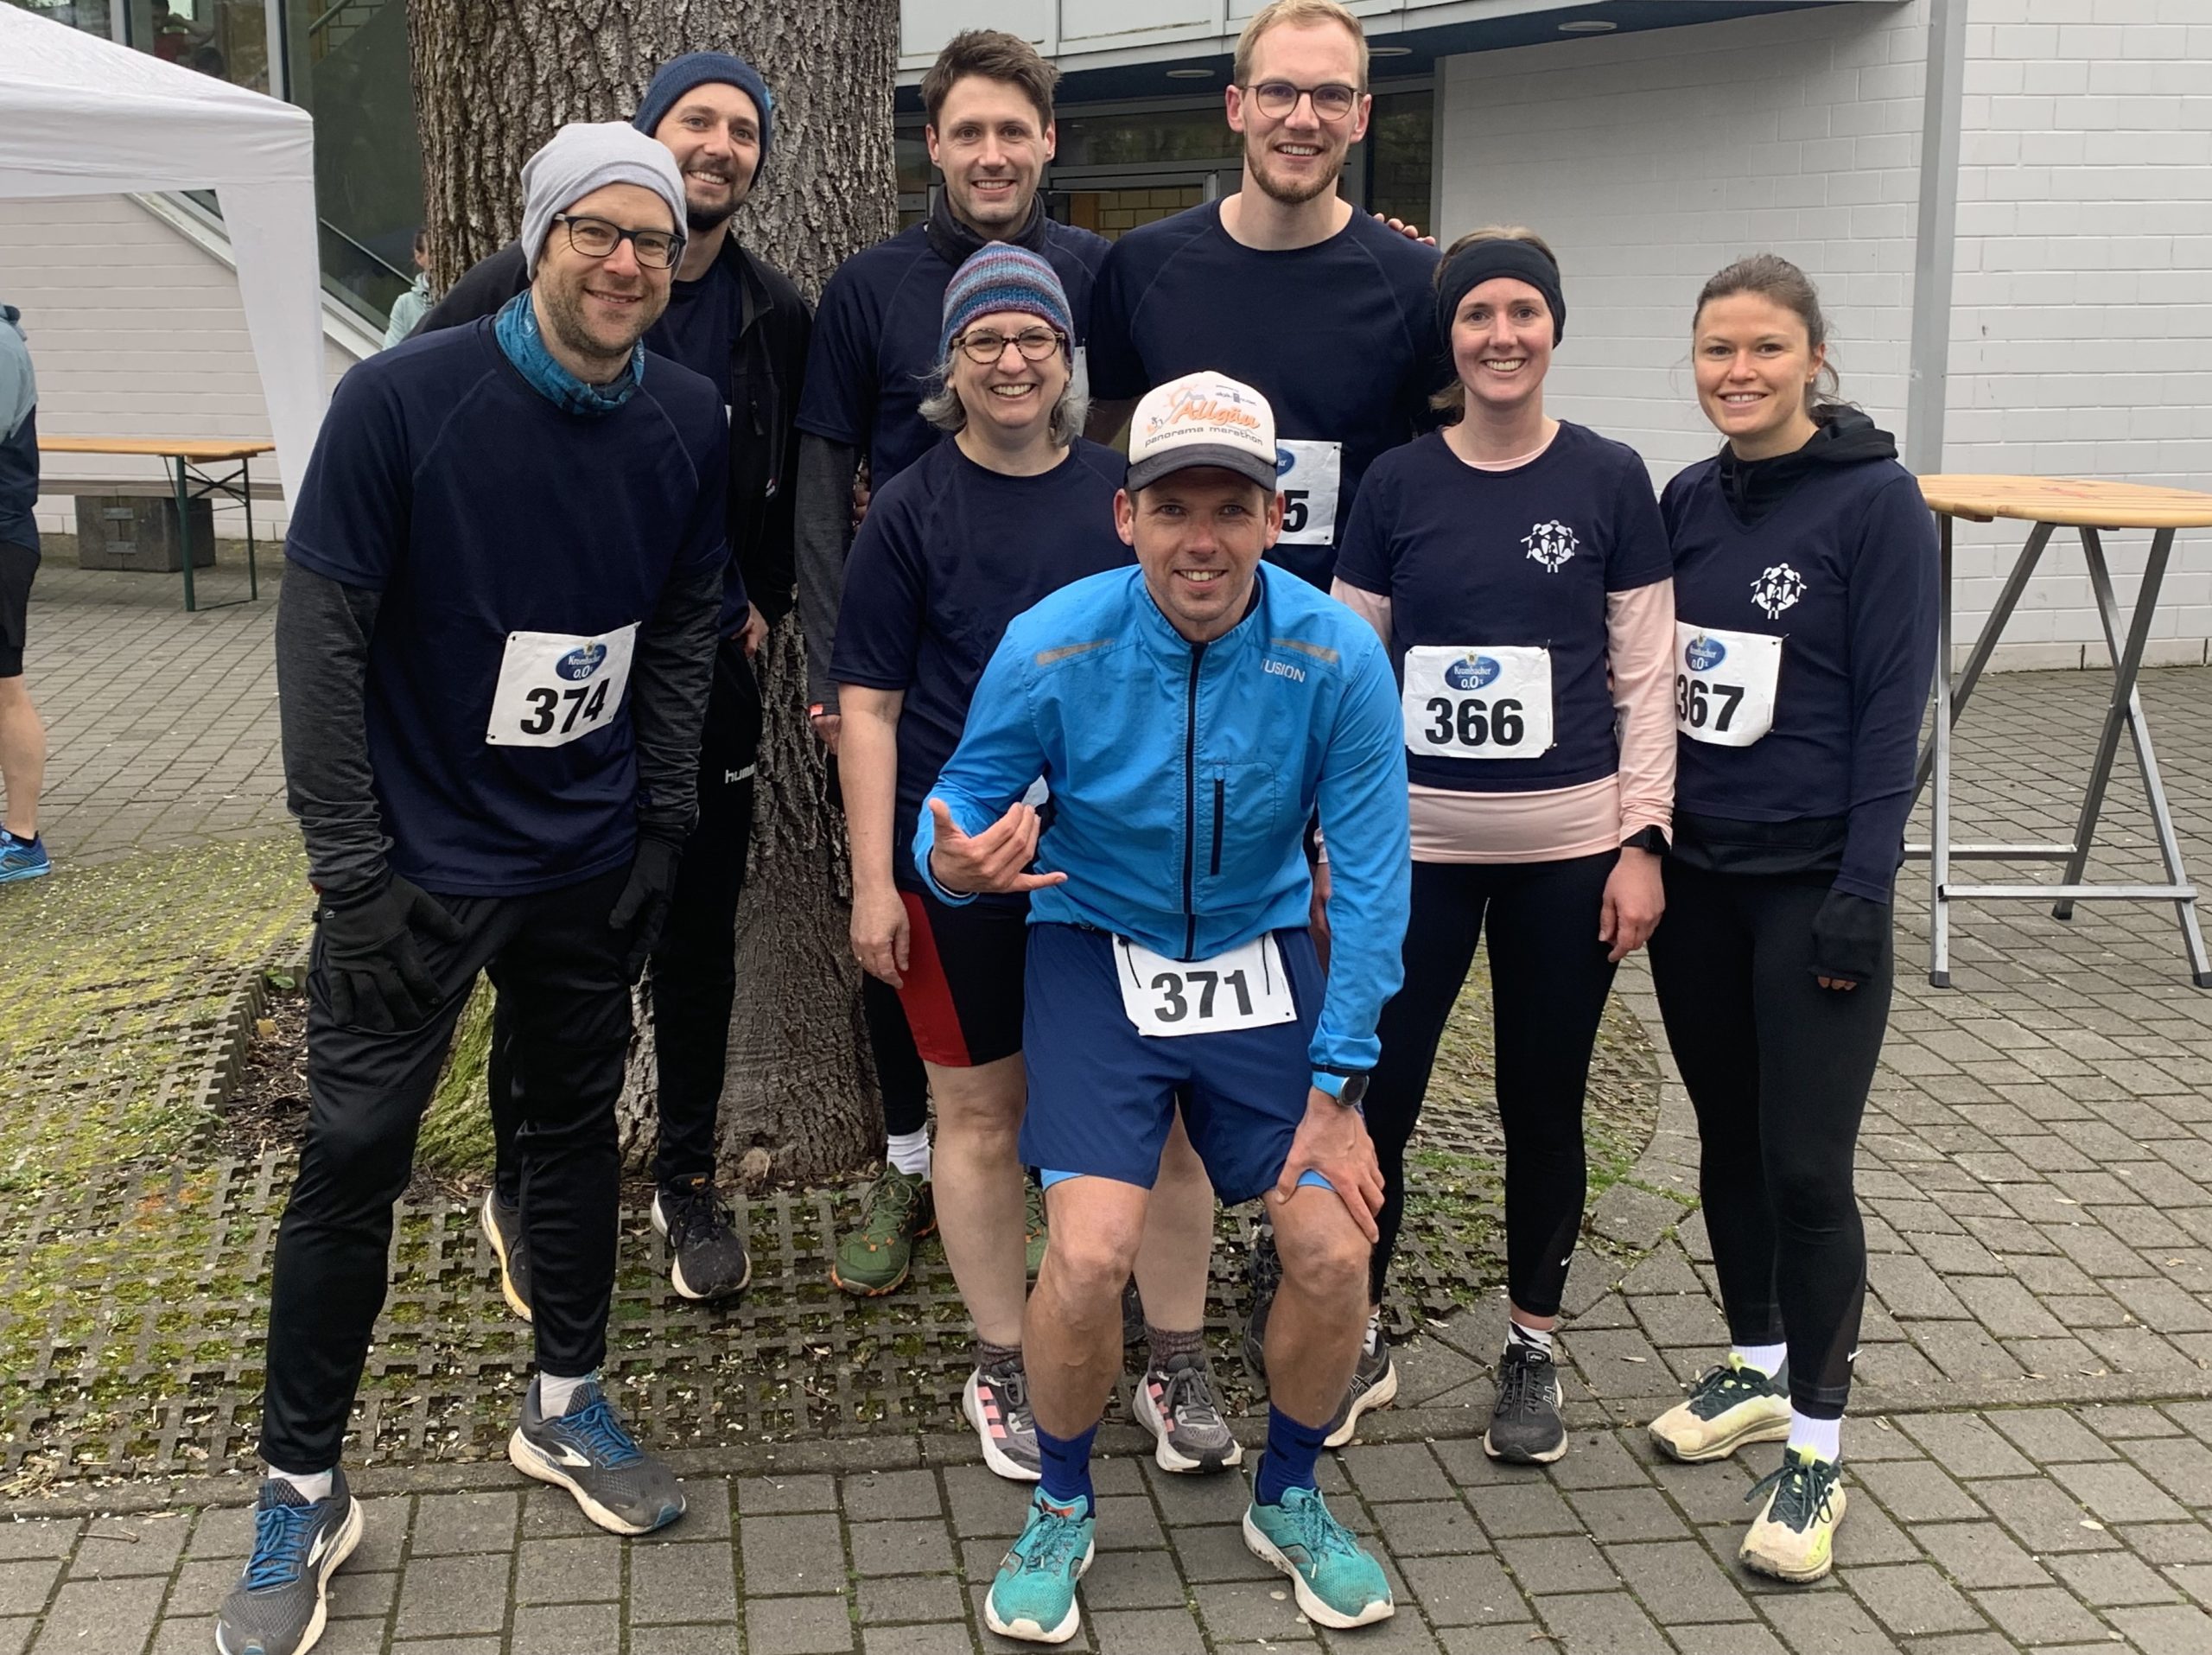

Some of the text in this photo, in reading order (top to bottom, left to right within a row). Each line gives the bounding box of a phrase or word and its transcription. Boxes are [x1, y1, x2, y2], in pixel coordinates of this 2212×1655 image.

[1145, 427, 1263, 448] panorama marathon
[1170, 400, 1261, 430] Allgäu
[520, 678, 611, 735] 374
[1424, 697, 1524, 747] 366
[1677, 674, 1745, 732] 367
[1151, 969, 1254, 1023] 371
